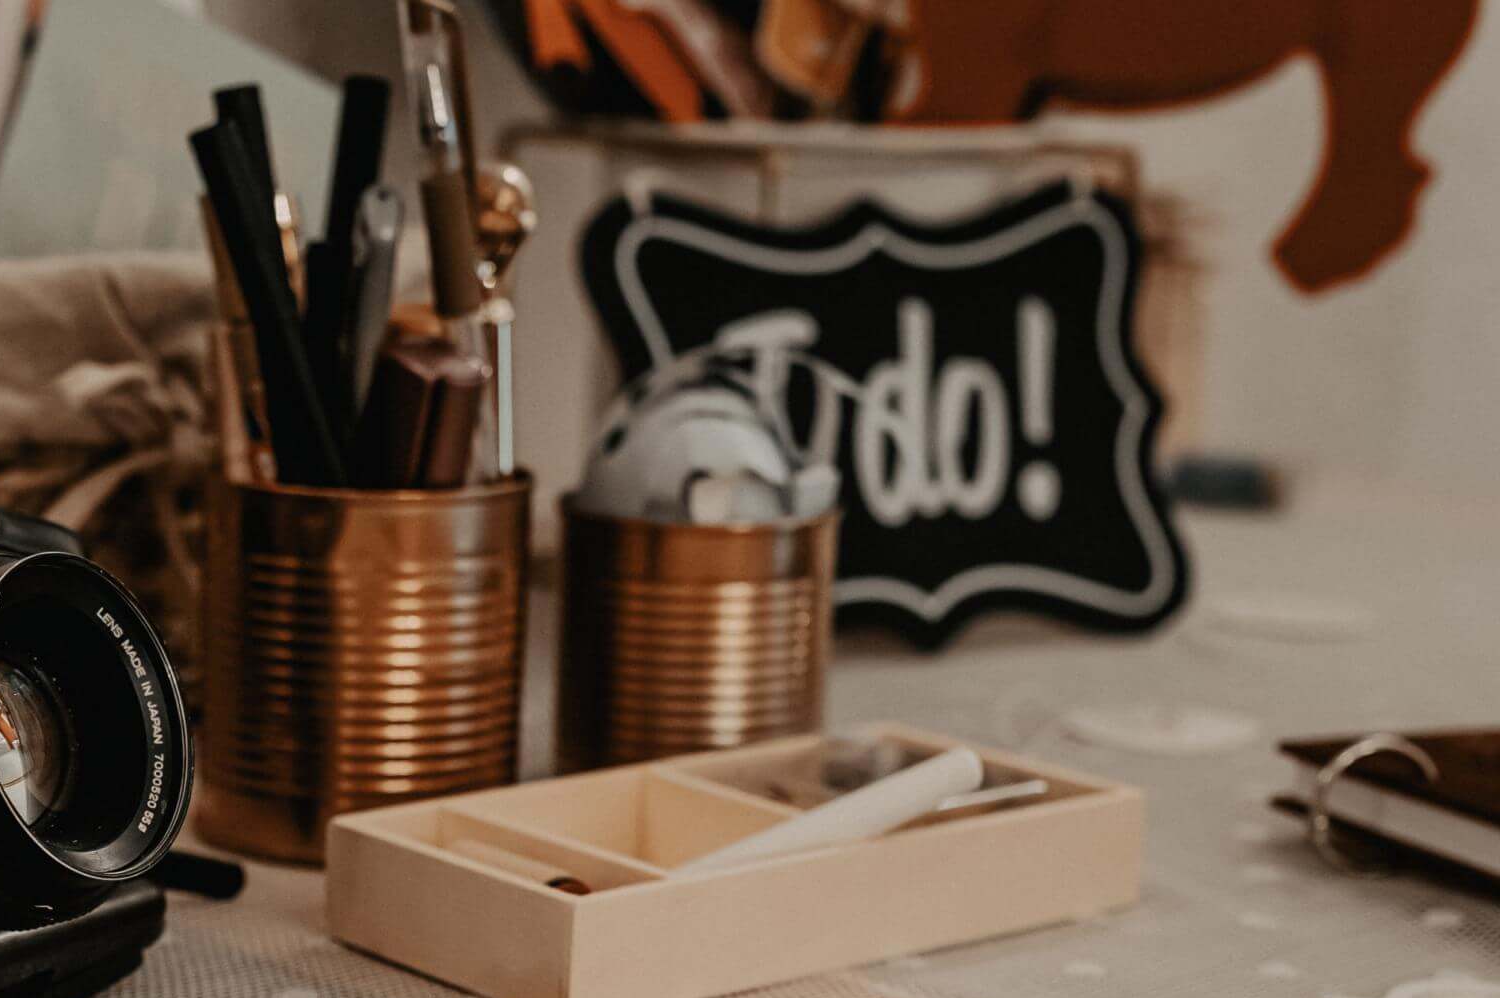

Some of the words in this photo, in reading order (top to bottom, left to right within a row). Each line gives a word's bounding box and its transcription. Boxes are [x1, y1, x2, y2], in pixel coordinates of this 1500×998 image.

[96, 606, 124, 639] LENS
[120, 638, 147, 679] MADE
[140, 680, 154, 698] IN
[146, 701, 165, 745] JAPAN
